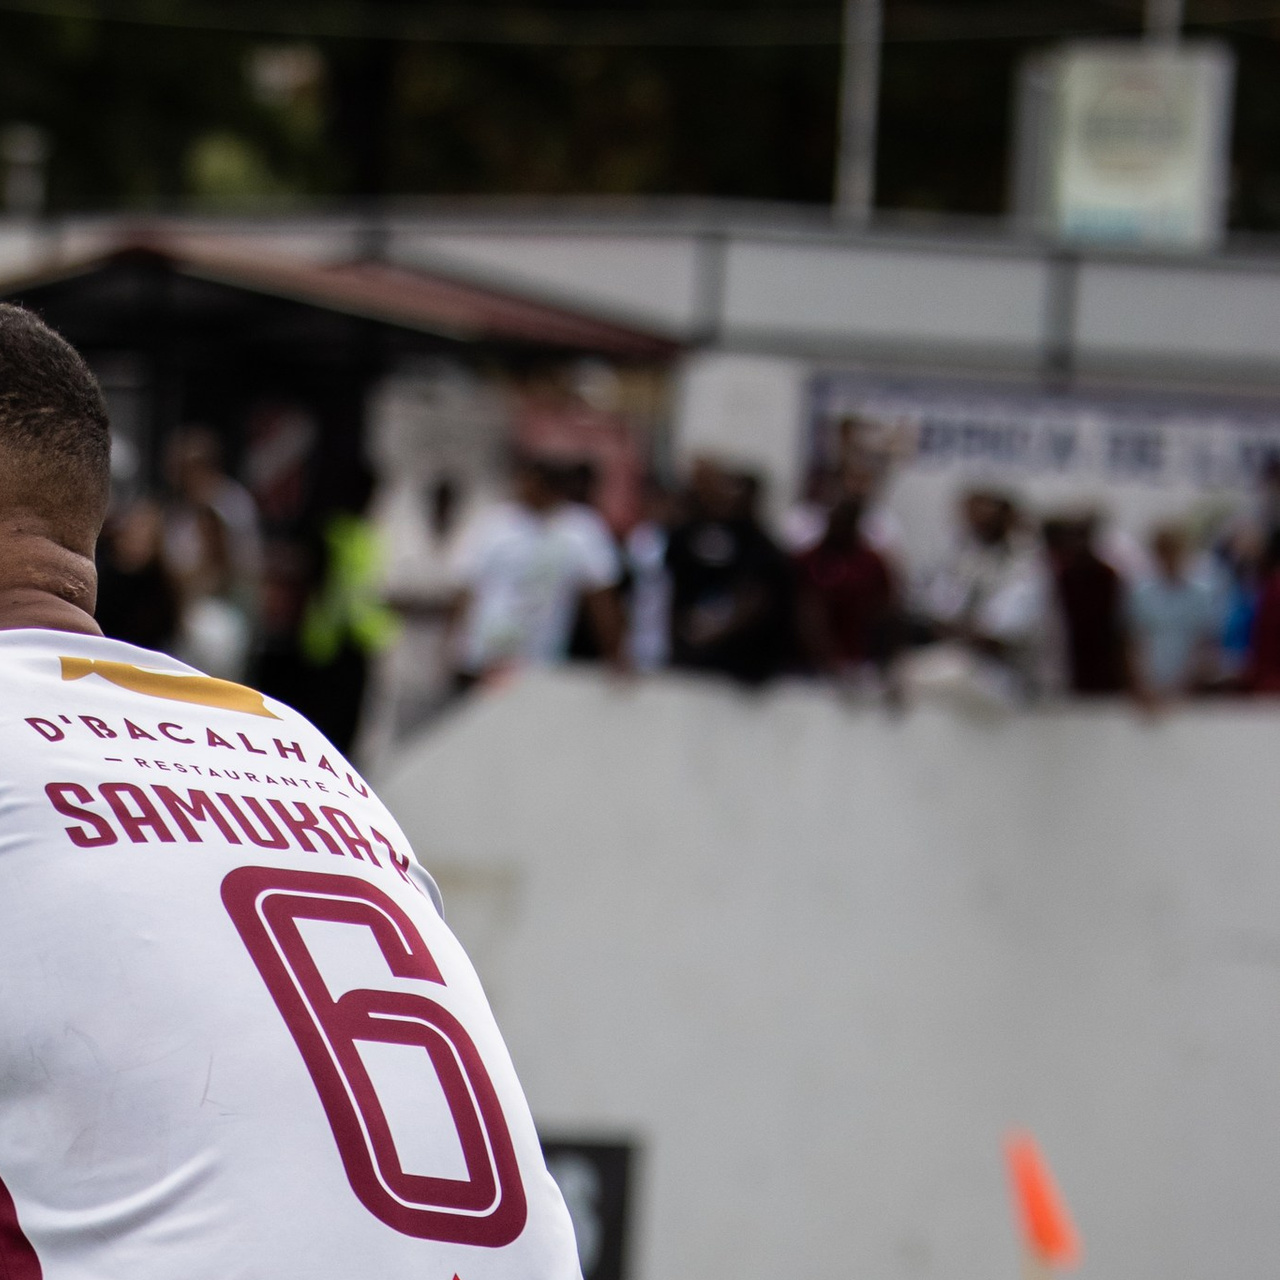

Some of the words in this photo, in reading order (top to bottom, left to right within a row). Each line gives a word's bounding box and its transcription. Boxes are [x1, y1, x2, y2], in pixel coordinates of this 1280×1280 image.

[24, 714, 370, 799] D'BACALHAU
[133, 756, 331, 794] RESTAURANTE
[220, 865, 528, 1248] 6
